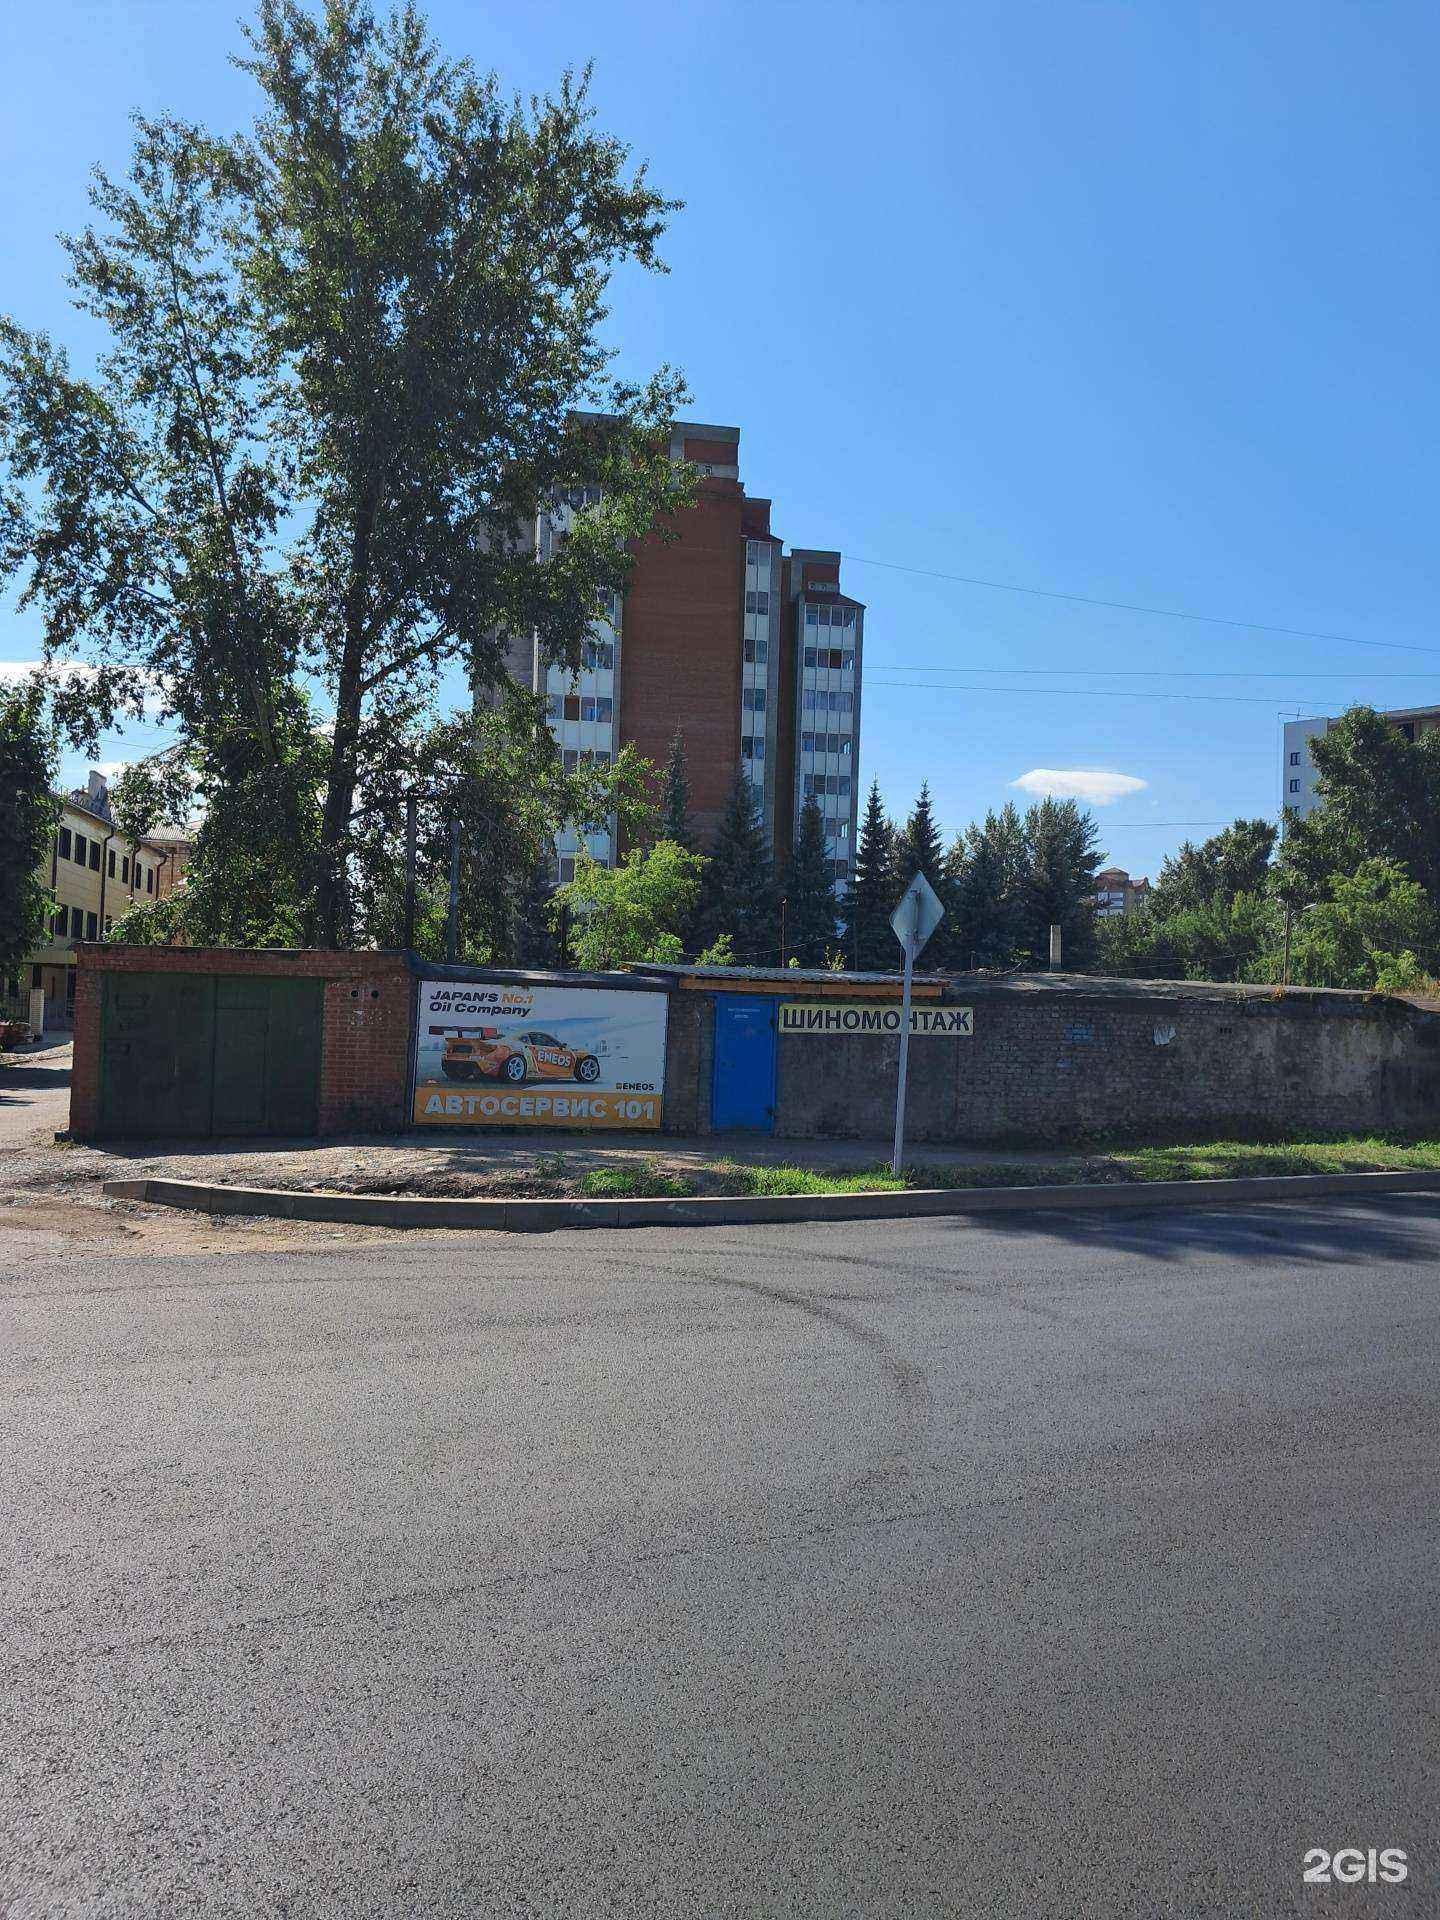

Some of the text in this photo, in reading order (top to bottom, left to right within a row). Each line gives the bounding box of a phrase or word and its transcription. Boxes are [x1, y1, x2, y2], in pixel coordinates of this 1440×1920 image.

[429, 990, 534, 1004] JAPAN'S No.1
[429, 1001, 531, 1017] Oil Company
[537, 1049, 571, 1067] ENEOS
[622, 1082, 655, 1091] ENEOS
[424, 1094, 655, 1120] АВТОСЕРВИС 101
